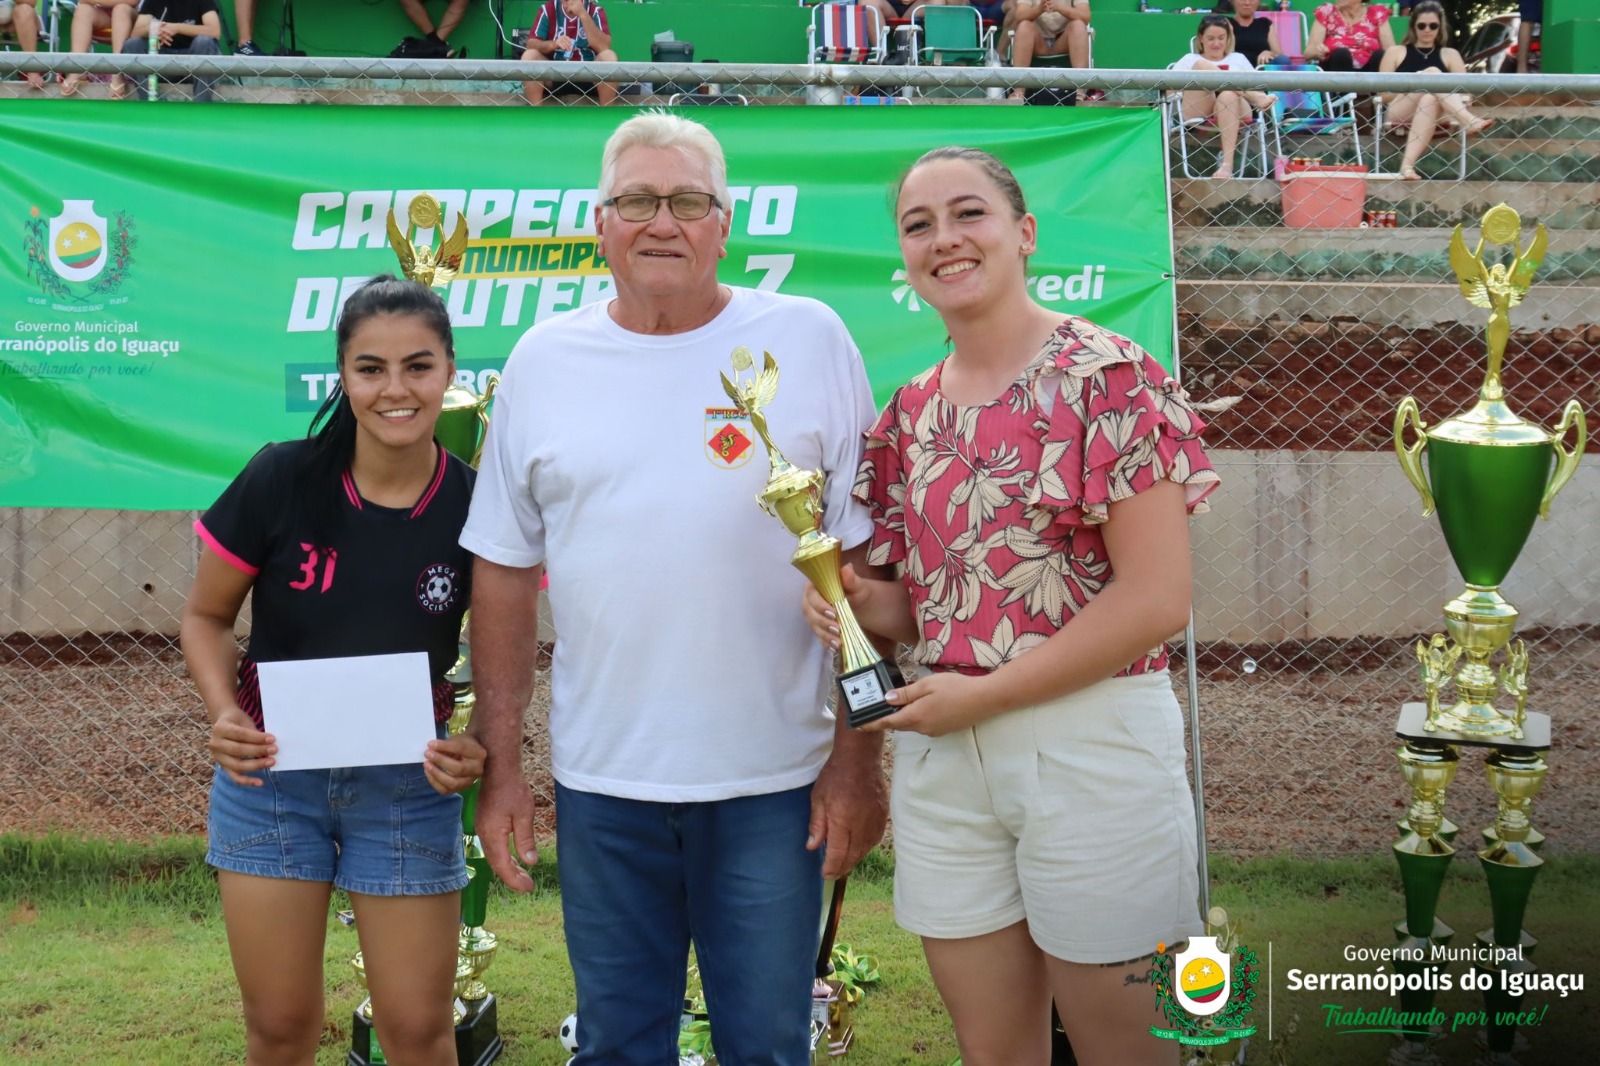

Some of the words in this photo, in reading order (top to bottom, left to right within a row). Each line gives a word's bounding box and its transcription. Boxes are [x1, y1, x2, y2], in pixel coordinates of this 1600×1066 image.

[292, 186, 798, 250] CAMPEOO
[463, 241, 611, 274] MUNICIP
[745, 253, 795, 294] 7
[15, 320, 70, 332] Governo
[74, 320, 139, 335] Municipal
[94, 336, 117, 352] do
[122, 337, 179, 357] Iguaçu
[88, 364, 112, 379] por
[427, 565, 455, 580] MEGA
[419, 593, 454, 611] SOCIETY
